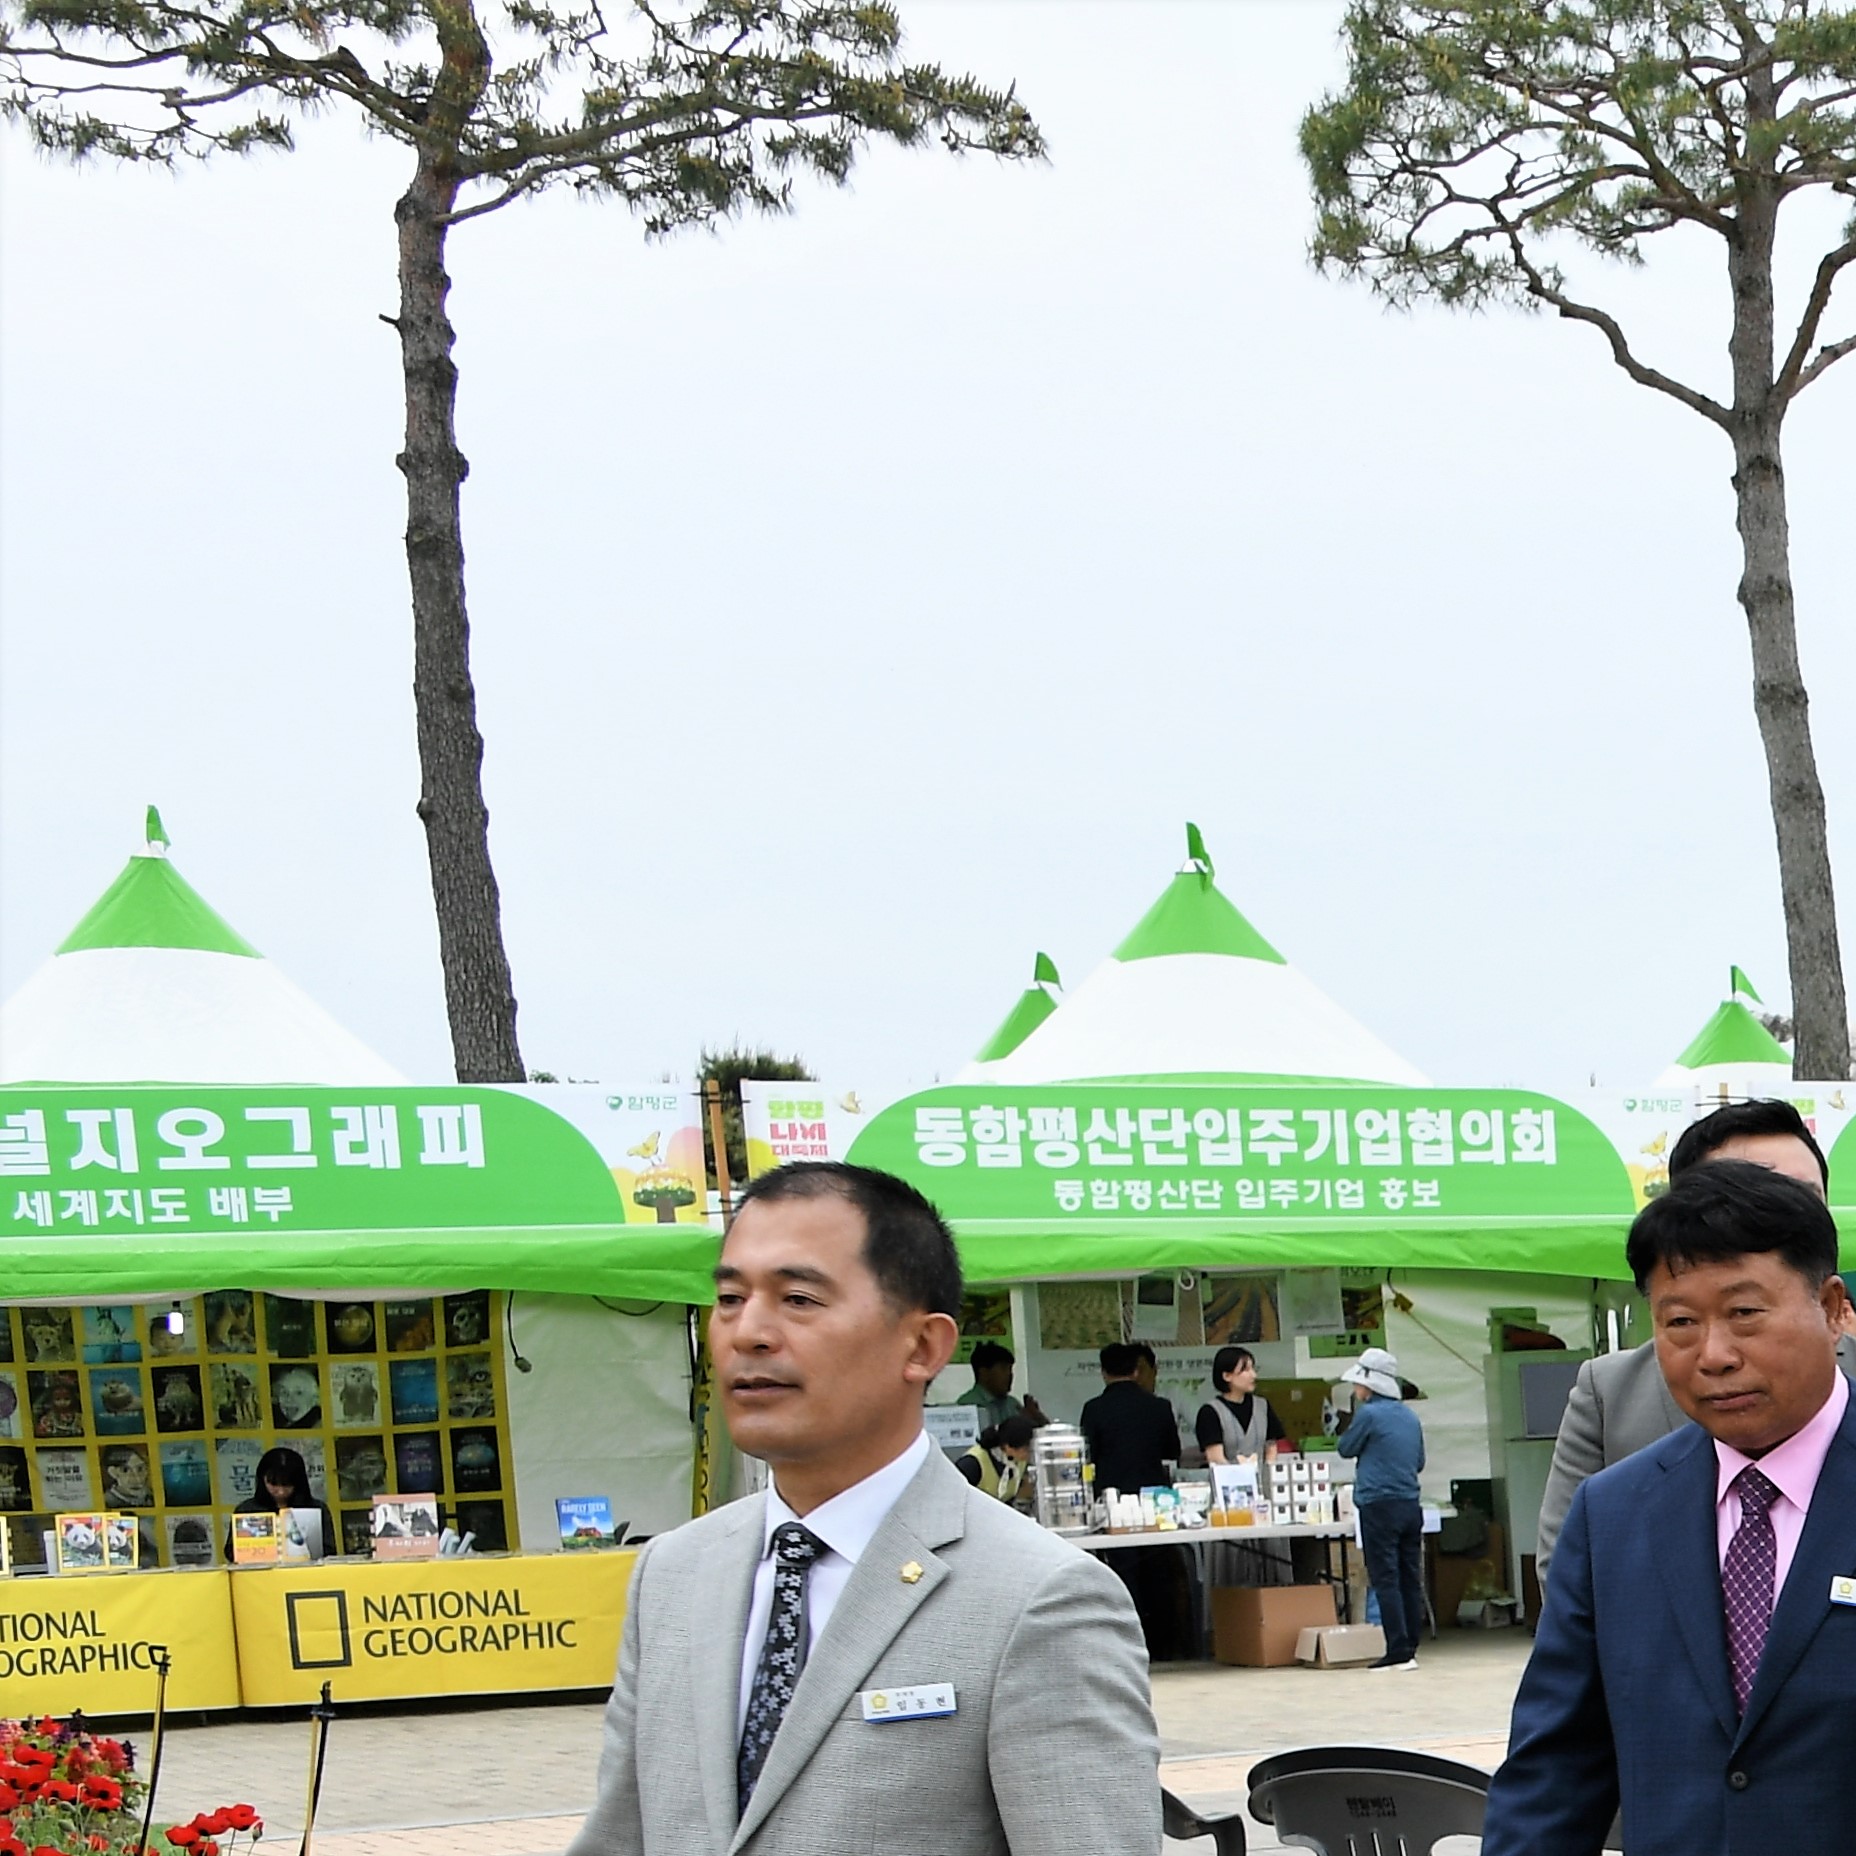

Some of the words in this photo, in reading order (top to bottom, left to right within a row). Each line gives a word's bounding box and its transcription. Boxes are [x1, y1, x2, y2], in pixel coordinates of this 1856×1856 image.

[0, 1103, 485, 1175] 널지오그래피
[914, 1105, 1557, 1167] 동함평산단입주기업협의회
[14, 1188, 190, 1226] 세계지도
[209, 1186, 293, 1223] 배부
[1054, 1178, 1223, 1211] 동함평산단
[1235, 1178, 1364, 1210] 입주기업
[1379, 1178, 1441, 1210] 홍보
[362, 1589, 530, 1624] NATIONAL
[0, 1610, 106, 1643] TIONAL
[363, 1619, 578, 1658] GEOGRAPHIC
